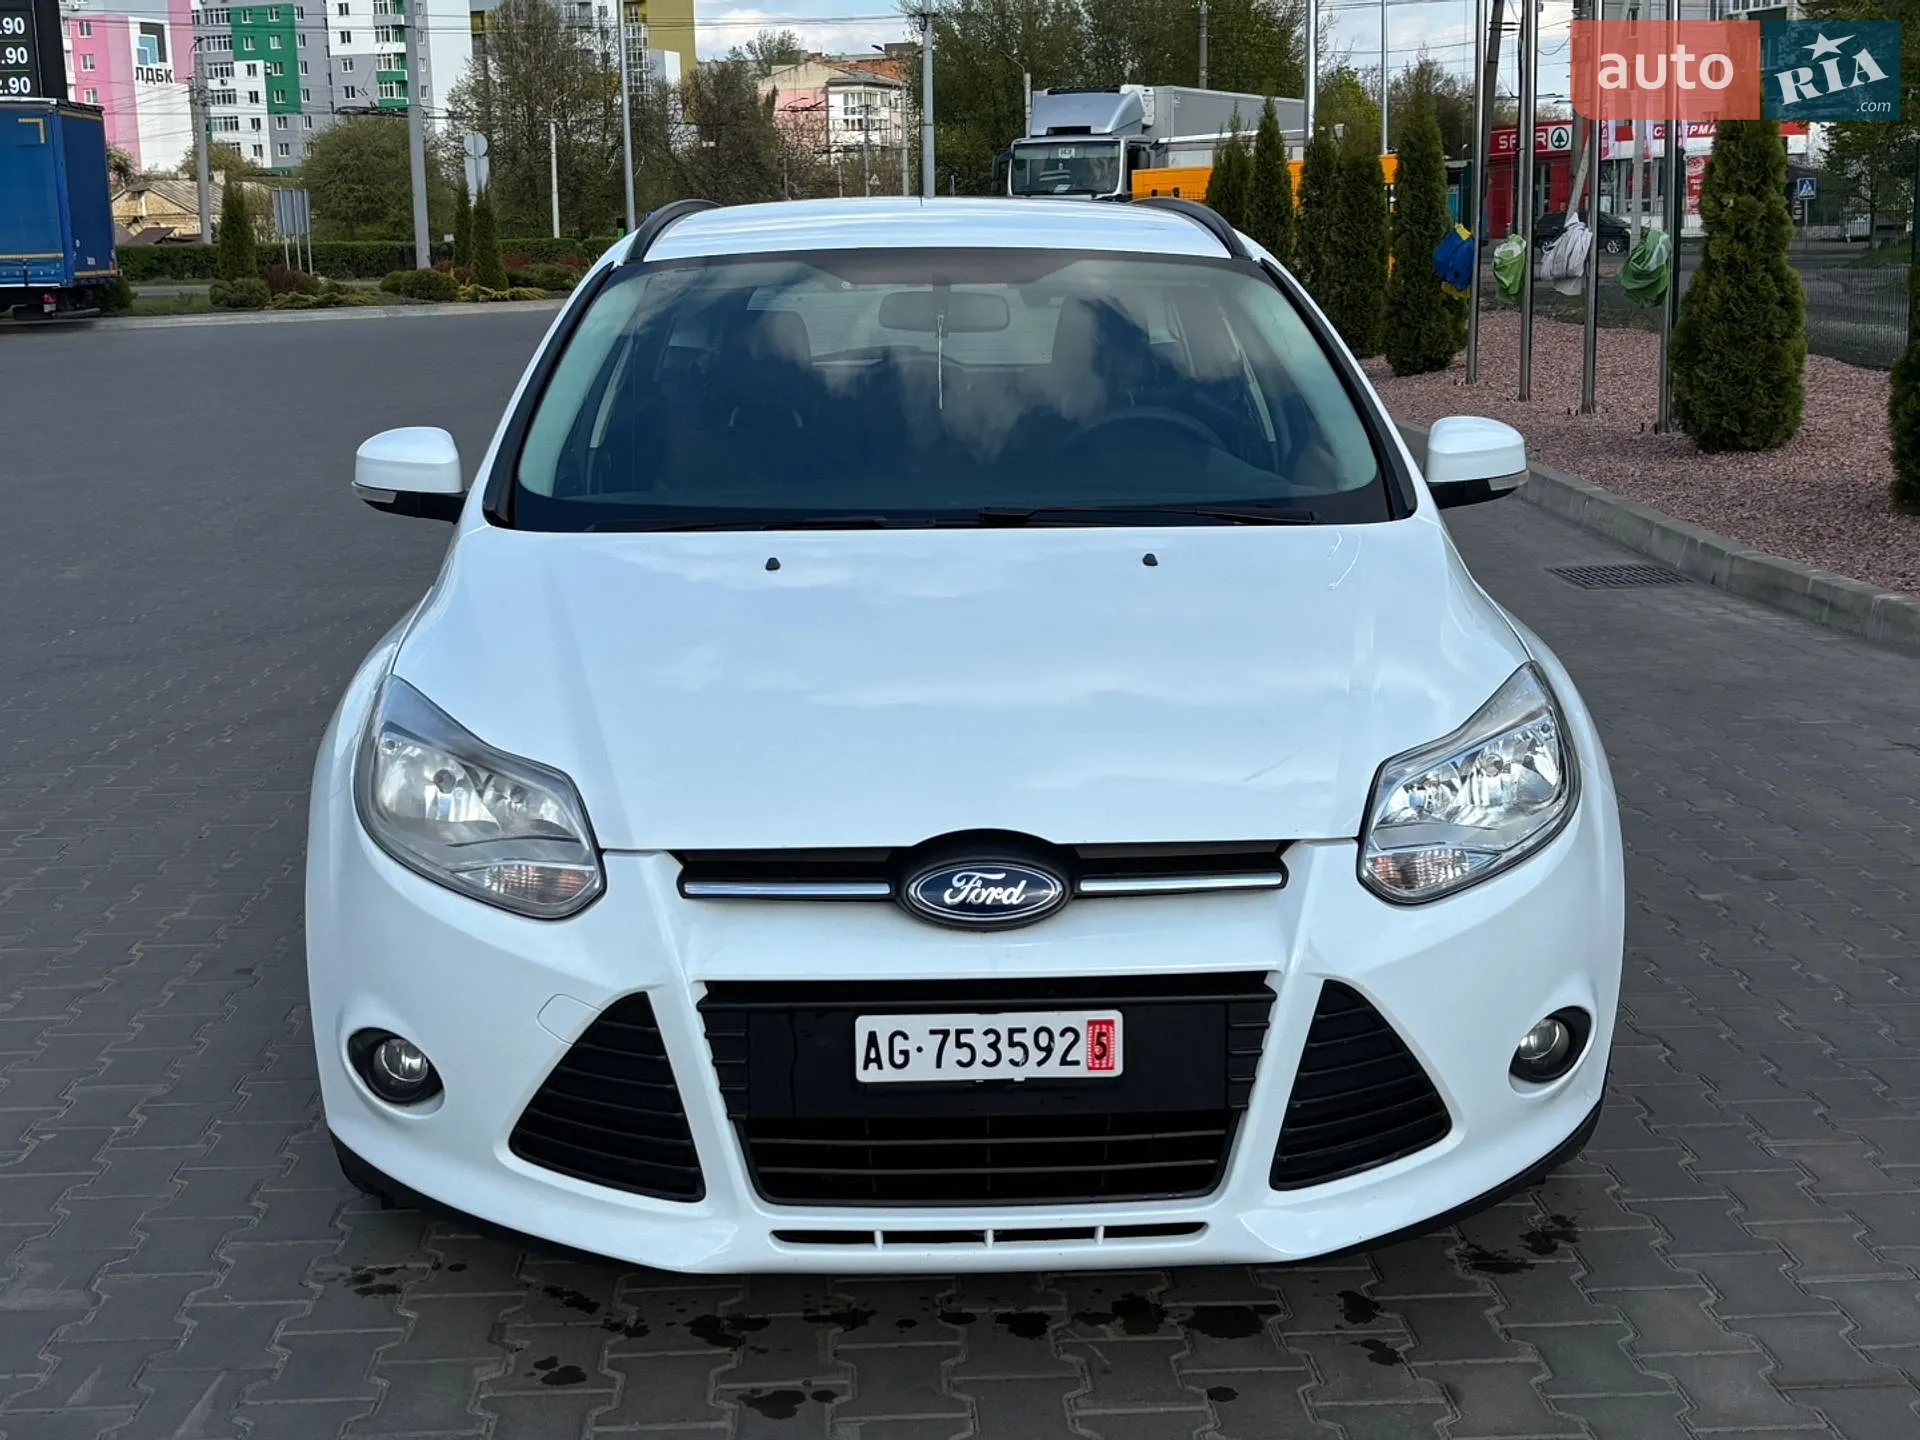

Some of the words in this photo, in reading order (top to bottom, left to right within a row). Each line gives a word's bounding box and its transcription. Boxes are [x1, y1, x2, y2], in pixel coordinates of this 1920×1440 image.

[135, 67, 174, 84] ЛДБК
[0, 76, 31, 94] .90
[1498, 131, 1547, 149] SPR
[944, 871, 1027, 905] Ford
[1094, 1031, 1107, 1061] 5
